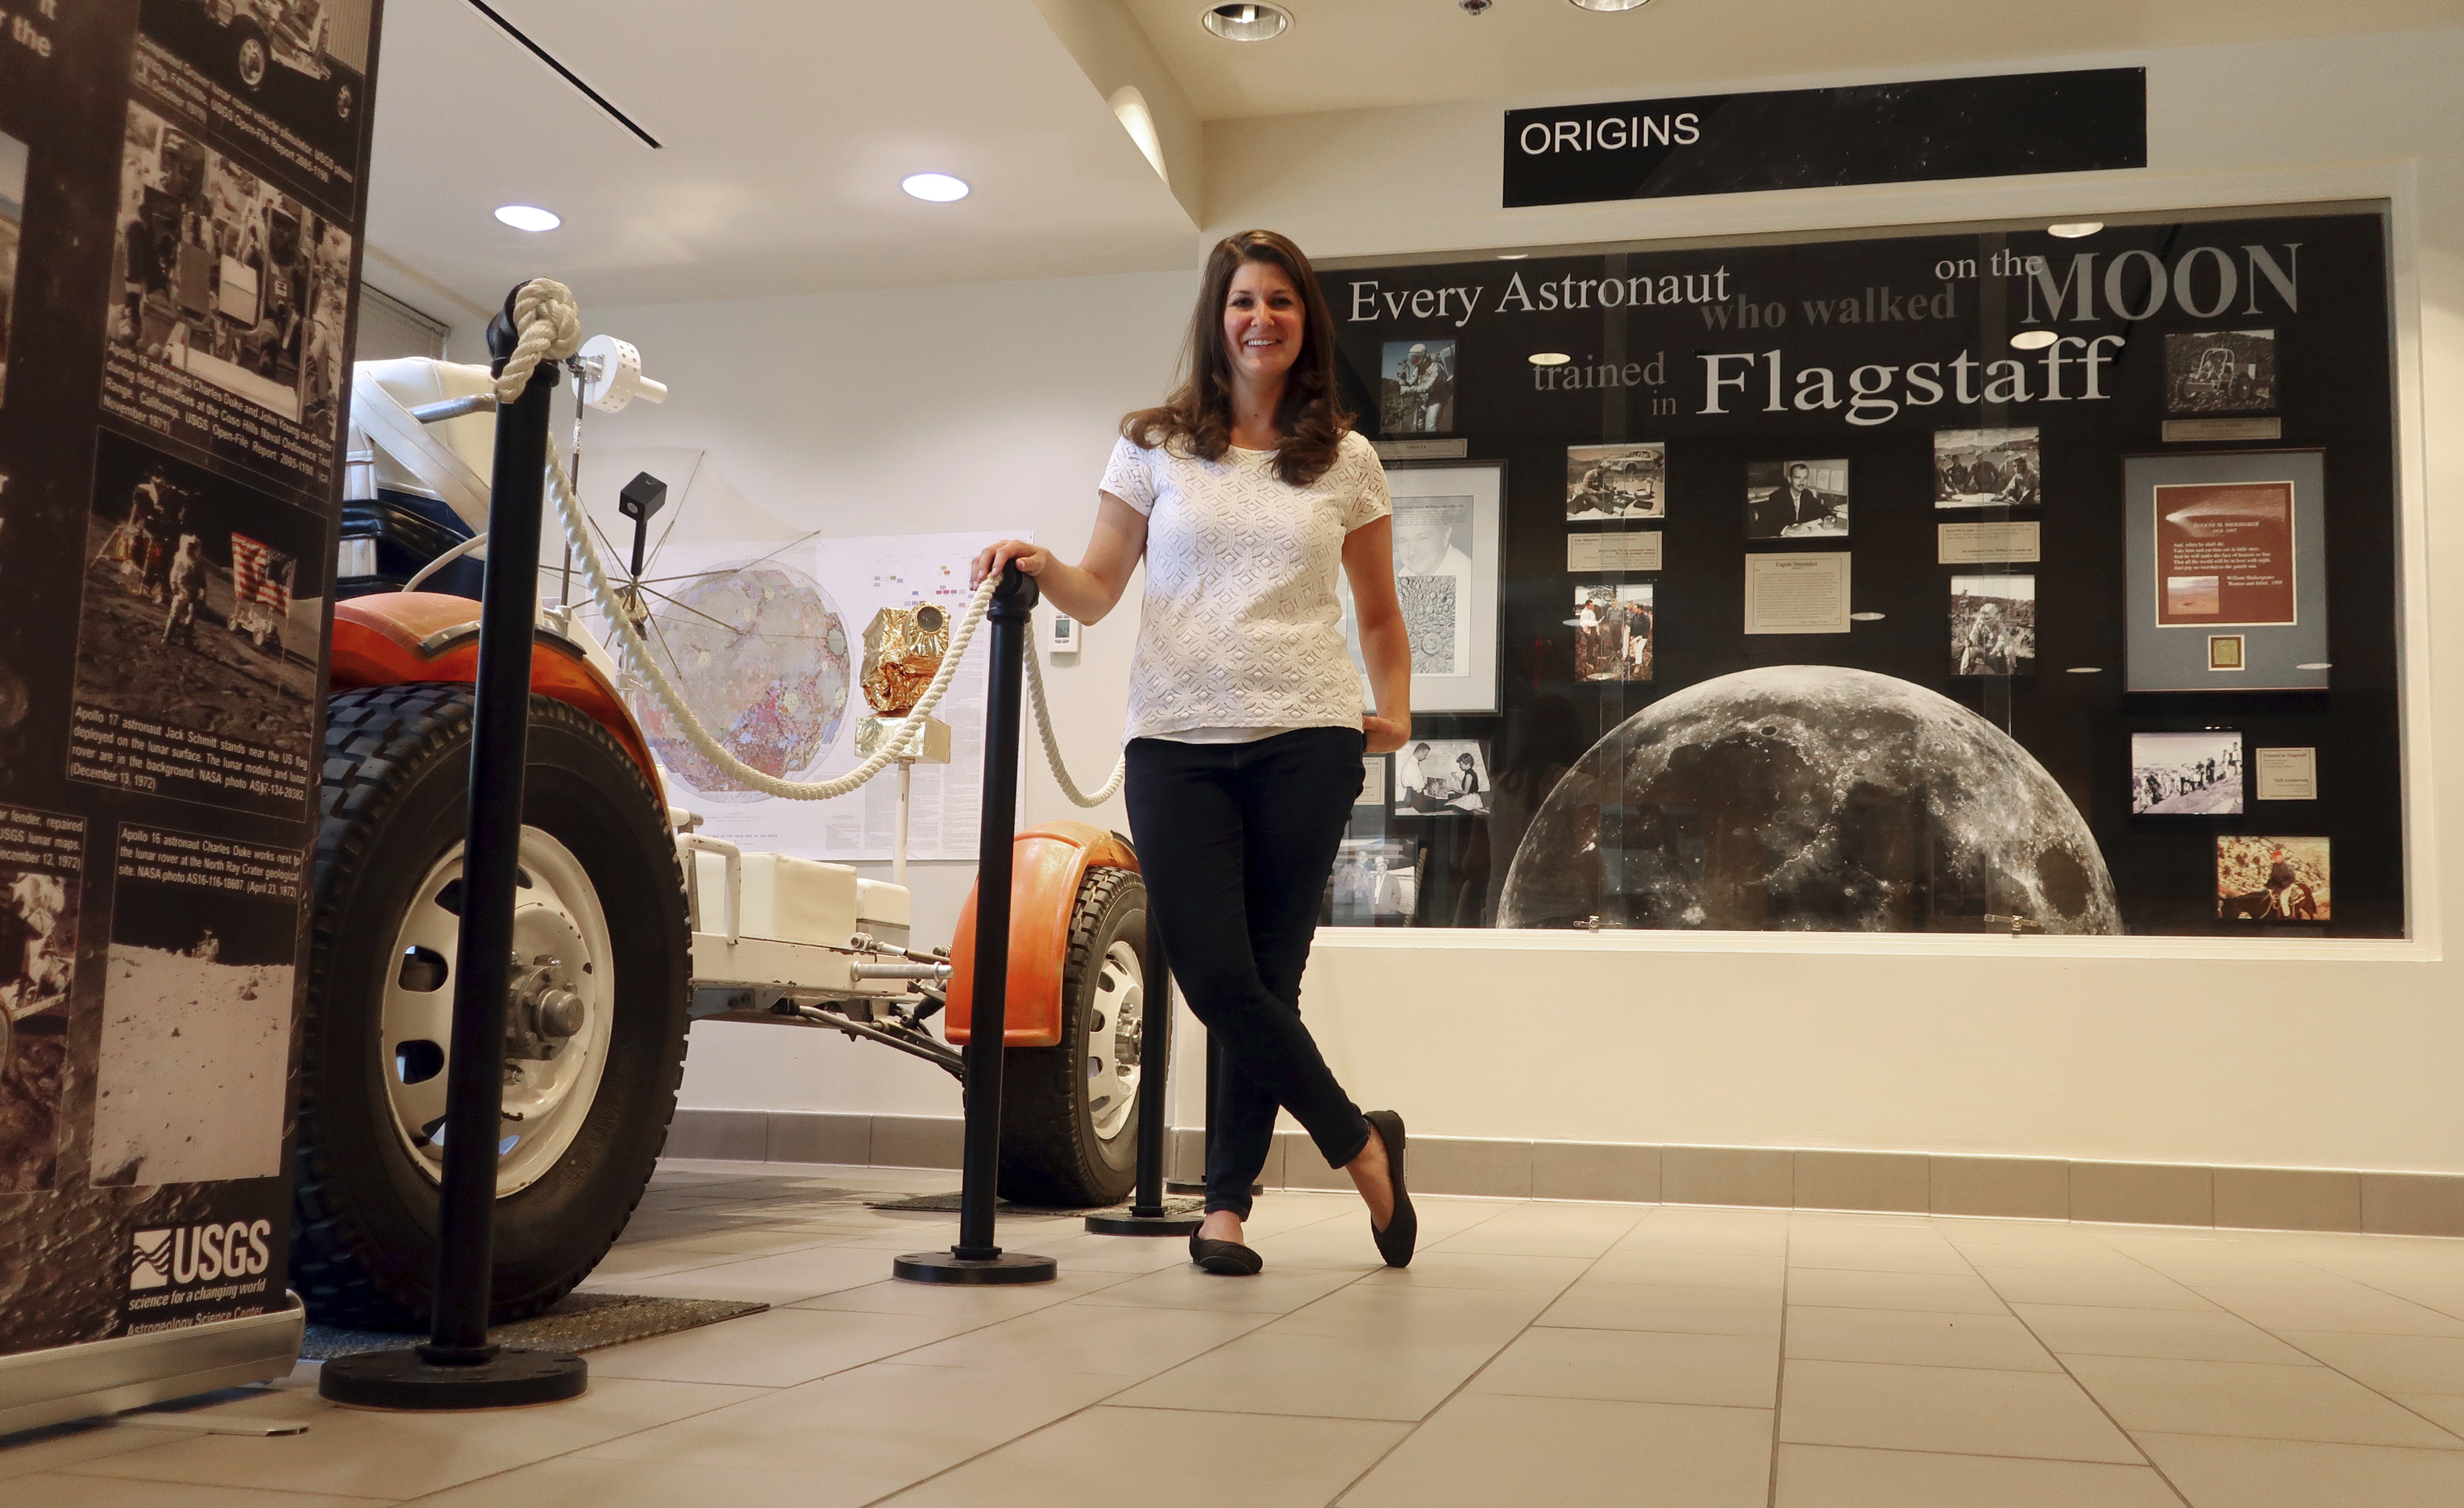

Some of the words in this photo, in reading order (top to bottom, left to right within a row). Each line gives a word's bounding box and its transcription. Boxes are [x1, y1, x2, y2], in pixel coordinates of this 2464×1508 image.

[12, 15, 52, 58] the
[211, 81, 231, 102] lunar
[232, 97, 252, 114] rover
[314, 149, 334, 170] USGS
[211, 99, 233, 122] USGS
[235, 114, 269, 144] Open-File
[271, 137, 295, 161] Report
[1520, 113, 1700, 155] ORIGINS
[1347, 280, 1485, 328] Every
[1494, 264, 1731, 314] Astronaut
[1934, 259, 1979, 280] on
[1989, 247, 2043, 279] the
[2021, 243, 2303, 324] MOON
[1700, 293, 1788, 331] who
[1802, 283, 1957, 326] walked
[1533, 351, 1667, 392] trained
[1652, 390, 1677, 417] in
[1695, 334, 2126, 426] Flagstaff
[103, 393, 148, 423] November
[193, 380, 222, 402] Charles
[223, 393, 243, 411] Duke
[243, 405, 258, 418] and
[260, 410, 277, 427] John
[278, 418, 300, 440] Young
[301, 431, 310, 442] on
[310, 434, 332, 452] Grover
[185, 411, 209, 431] USGS
[212, 424, 249, 449] Open-File
[251, 441, 276, 461] Report
[196, 401, 206, 413] at
[206, 403, 219, 418] the
[220, 409, 241, 428] Coso
[242, 418, 259, 436] Hills
[260, 427, 280, 446] Naval
[282, 437, 317, 462] Ordinance
[318, 453, 331, 469] Test
[73, 725, 114, 745] deployed
[117, 737, 129, 747] on
[131, 737, 145, 750] the
[148, 741, 170, 755] lunar
[172, 748, 203, 763] surface.
[206, 752, 221, 766] The
[222, 757, 243, 771] lunar
[244, 764, 272, 778] module
[274, 770, 289, 780] and
[289, 771, 308, 785] lunar
[75, 705, 105, 724] Apollo
[108, 712, 119, 726] 17
[122, 718, 163, 736] astronaut
[164, 726, 185, 741] Jack
[188, 730, 218, 749] Schmitt
[220, 741, 246, 755] stands
[248, 746, 266, 759] near
[268, 750, 280, 762] the
[282, 752, 293, 766] US
[295, 755, 309, 771] flag
[70, 762, 118, 782] (December
[134, 774, 157, 792] 1972)
[72, 746, 96, 759] rover
[98, 751, 114, 762] are
[117, 752, 126, 765] in
[129, 755, 143, 769] the
[146, 758, 196, 779] background.
[198, 768, 222, 785] NASA
[224, 775, 247, 789] photo
[28, 831, 52, 847] lunar
[54, 838, 81, 852] maps.
[46, 817, 83, 833] repaired
[0, 850, 40, 864] ecember
[43, 853, 56, 866] 12,
[58, 854, 81, 872] 1972)
[120, 845, 134, 858] the
[135, 847, 157, 862] lunar
[158, 854, 179, 865] rover
[180, 855, 189, 866] at
[189, 855, 202, 868] the
[203, 858, 225, 870] North
[226, 861, 241, 876] Ray
[242, 863, 264, 877] Crater
[264, 869, 301, 883] geological
[121, 828, 148, 843] Apollo
[152, 832, 161, 845] 16
[163, 836, 201, 850] astronaut
[202, 840, 231, 855] Charles
[232, 845, 252, 858] Duke
[253, 850, 275, 862] works
[276, 854, 293, 865] next
[293, 855, 301, 866] to
[118, 865, 136, 877] site.
[137, 866, 161, 880] NASA
[162, 870, 185, 883] photo
[247, 881, 267, 895] (April
[279, 885, 297, 899] 1972)
[173, 1219, 272, 1285] USGS
[128, 1294, 169, 1311] science
[170, 1290, 187, 1305] for
[186, 1291, 193, 1302] a
[193, 1282, 239, 1302] changing
[239, 1278, 268, 1296] world
[195, 1312, 233, 1327] Science
[234, 1306, 265, 1319] Center
